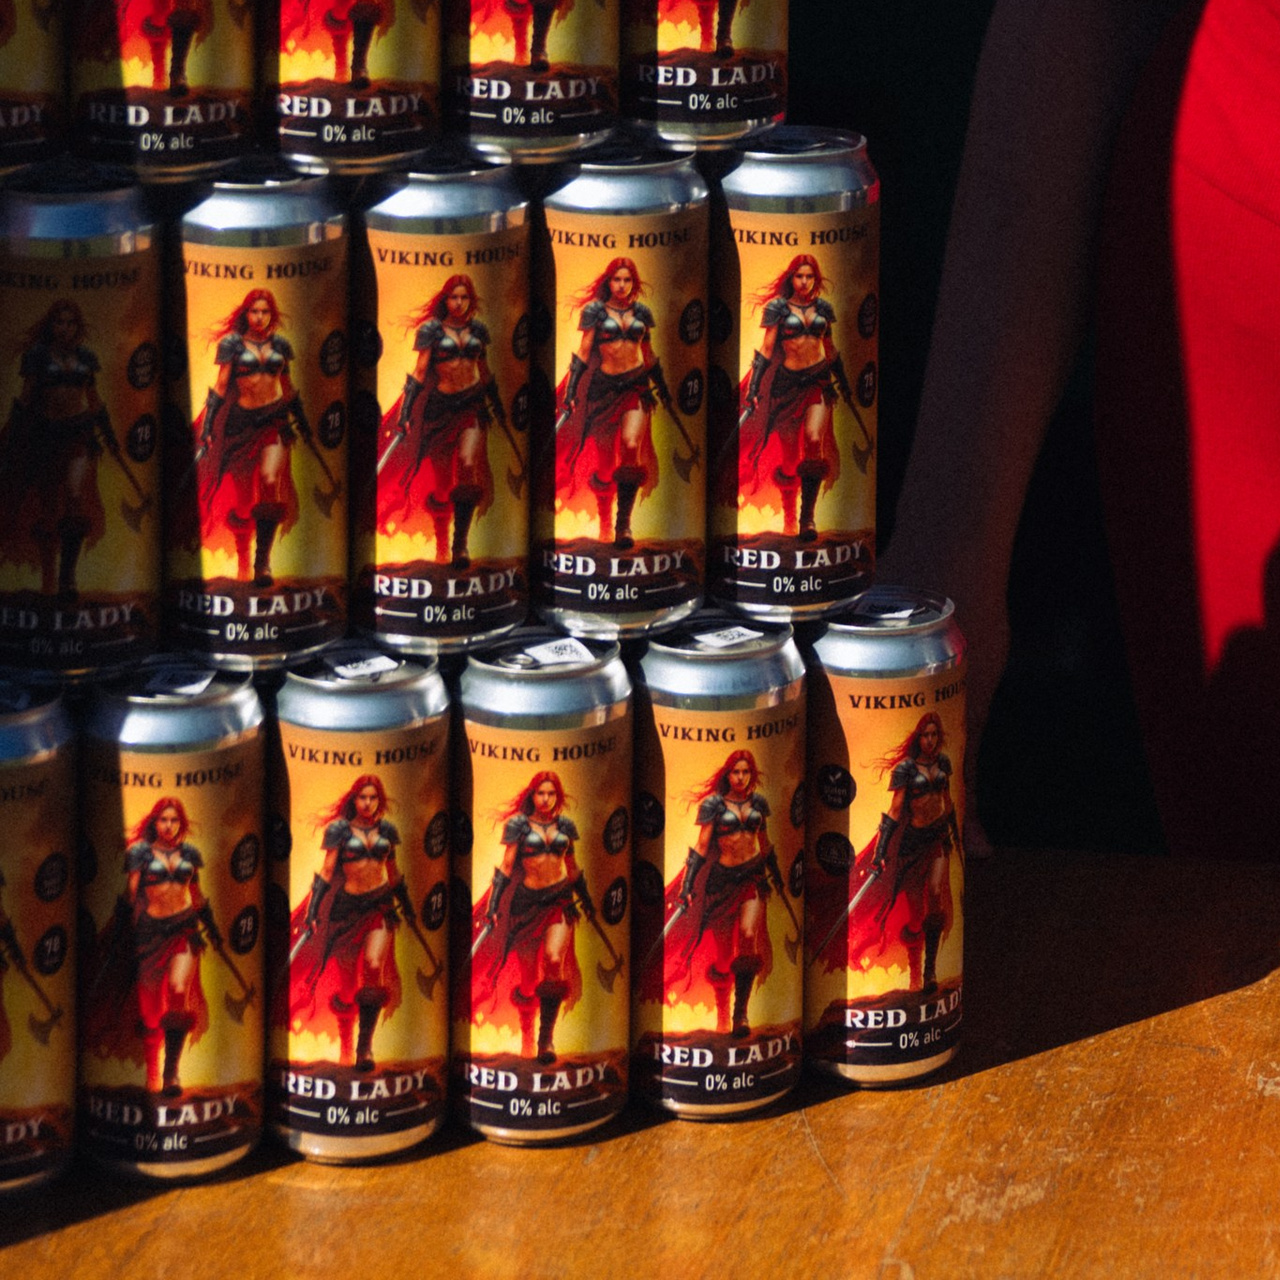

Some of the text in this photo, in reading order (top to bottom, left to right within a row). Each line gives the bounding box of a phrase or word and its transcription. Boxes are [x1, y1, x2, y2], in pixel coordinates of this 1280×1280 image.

[639, 62, 777, 86] RED LADY
[458, 76, 600, 100] RED LADY
[277, 93, 423, 118] RED LADY
[689, 93, 738, 109] 0% alc
[164, 100, 239, 126] LADY
[502, 108, 554, 124] 0% alc
[140, 133, 194, 150] 0% alc
[322, 125, 376, 141] 0% alc
[548, 228, 692, 248] VIKING HOUSE
[729, 225, 868, 246] VIKING HOUSE
[378, 246, 520, 266] VIKING HOUSE
[184, 260, 331, 280] VIKING HOUSE
[543, 548, 686, 576] RED LADY
[724, 540, 863, 569] RED LADY
[374, 569, 517, 599] RED LADY
[587, 583, 638, 599] 0% alc
[772, 575, 822, 593] 0% alc
[179, 587, 327, 617] RED LADY
[424, 605, 475, 621] 0% alc
[225, 623, 279, 640] 0% alc
[849, 693, 926, 709] VIKING
[660, 715, 801, 742] VIKING HOUSE
[287, 743, 435, 765] VIKING HOUSE
[469, 740, 615, 762] VIKING HOUSE
[175, 767, 244, 786] HOUSE
[844, 1007, 907, 1029] RED
[899, 1029, 940, 1048] 0% alc
[655, 1035, 794, 1068] RED LADY
[282, 1070, 425, 1099] RED LADY
[464, 1062, 608, 1092] RED LADY
[704, 1073, 754, 1091] 0% alc
[156, 1095, 237, 1127] LADY
[327, 1106, 379, 1124] 0% alc
[509, 1098, 560, 1115] 0% alc
[163, 1133, 188, 1150] alc
